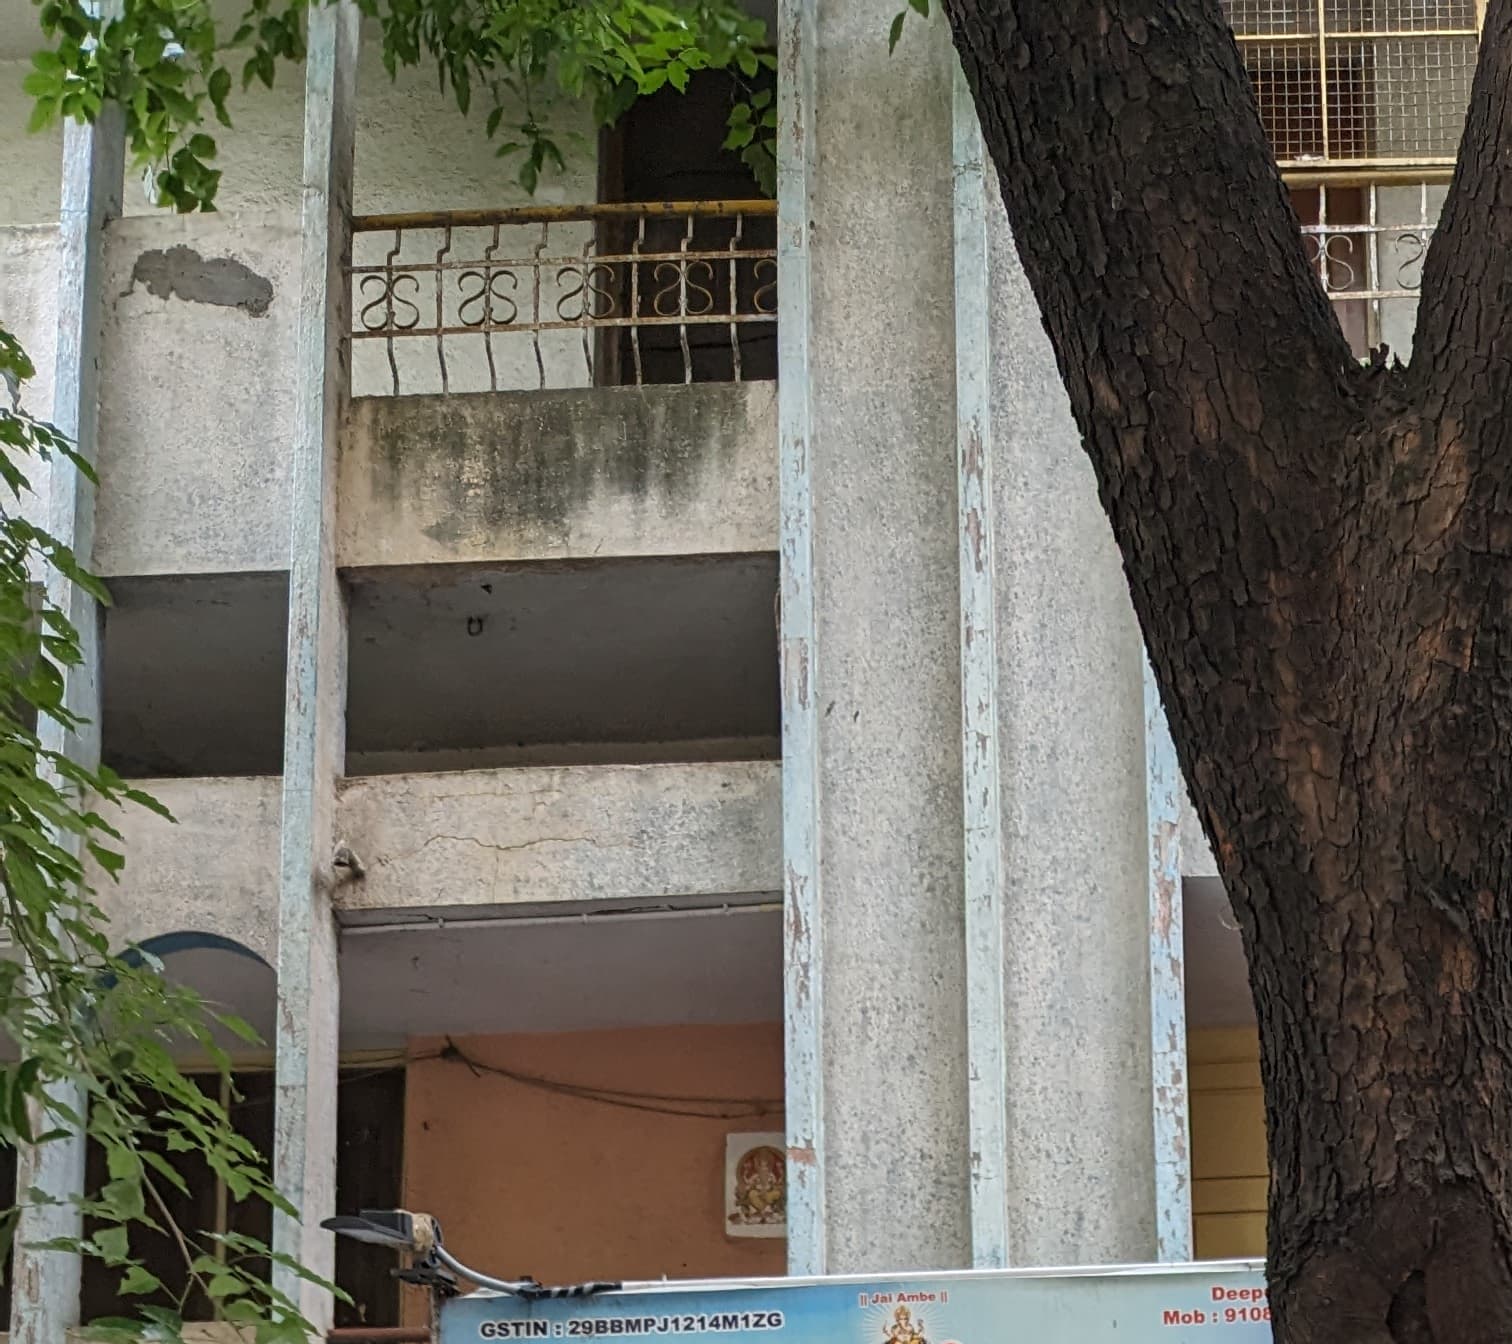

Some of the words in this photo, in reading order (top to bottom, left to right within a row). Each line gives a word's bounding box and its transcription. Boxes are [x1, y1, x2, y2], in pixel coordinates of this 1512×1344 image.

[872, 1293, 893, 1304] Jai
[897, 1292, 936, 1303] Ambe
[1211, 1286, 1267, 1303] Deep
[1163, 1309, 1205, 1325] Mob
[1225, 1306, 1272, 1322] 9108
[480, 1321, 548, 1338] GSTIN
[568, 1312, 782, 1336] 29BBMPJ1214M1ZG
